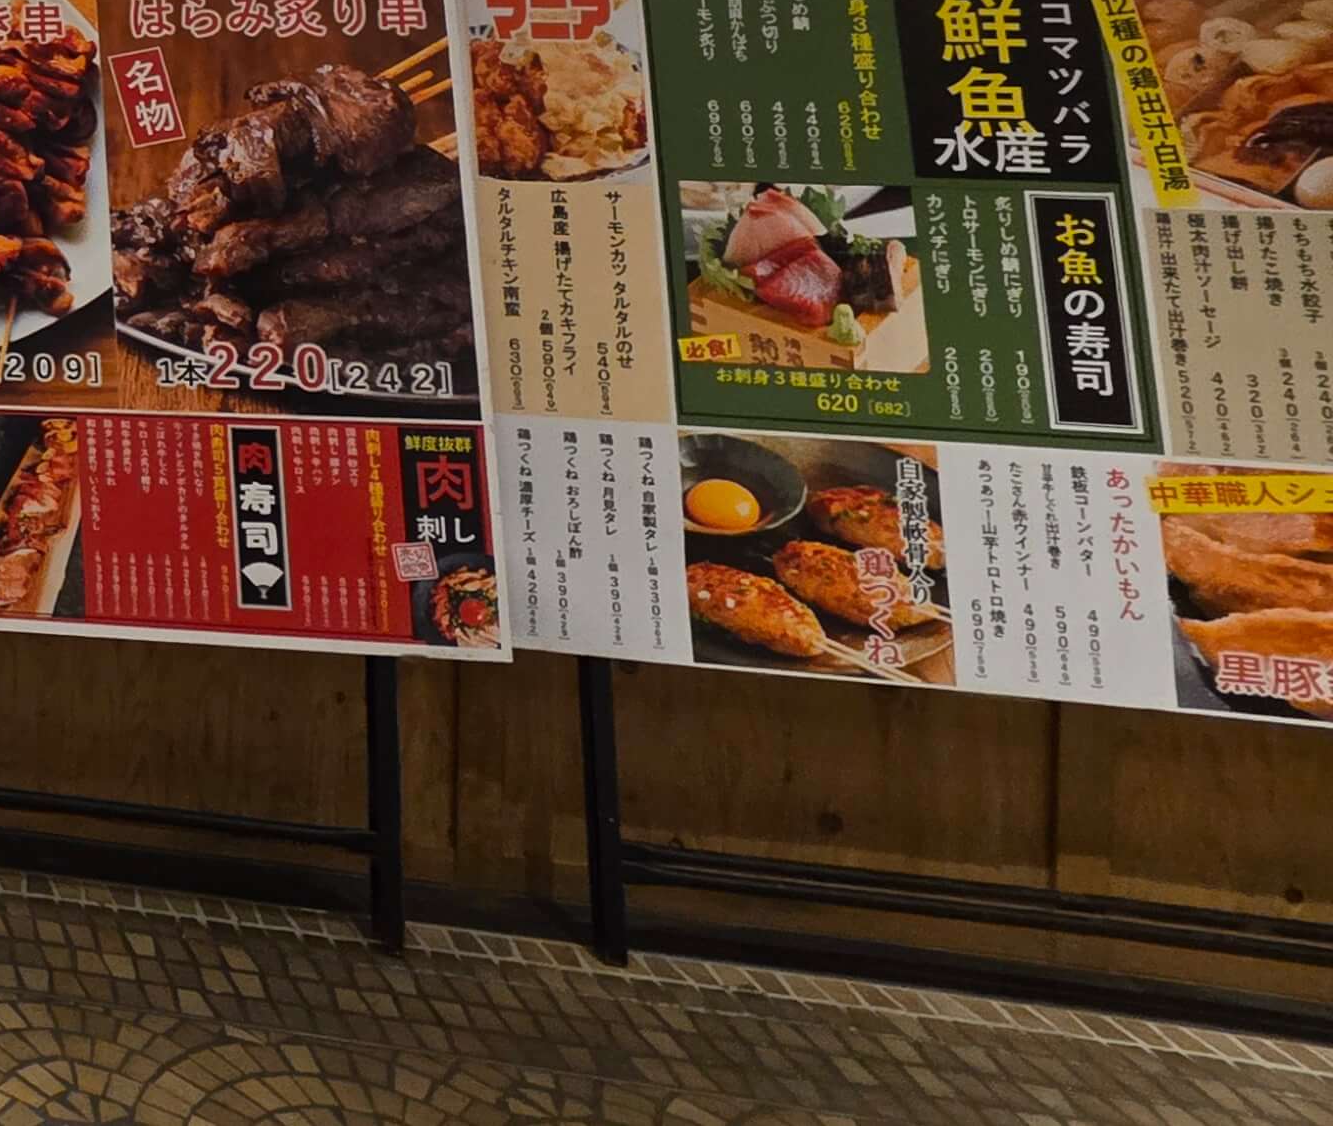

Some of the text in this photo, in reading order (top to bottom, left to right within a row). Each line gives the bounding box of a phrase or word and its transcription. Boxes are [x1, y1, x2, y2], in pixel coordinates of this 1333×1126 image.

[124, 59, 177, 137] 名物
[1041, 3, 1093, 164] コマツバラ
[933, 125, 1052, 174] 水産
[497, 186, 522, 317] タルタルチキン南蛮
[550, 189, 581, 376] 広島産 揚げたてカキフライ
[604, 190, 635, 370] サーモンカツ タルタルのせ
[1054, 212, 1115, 397] お魚の寿司
[404, 434, 473, 454] 鮮度抜群
[816, 392, 860, 414] 620
[237, 441, 280, 557] 肉寿司
[414, 513, 477, 545] 刺し
[415, 454, 475, 511] 肉
[1069, 464, 1095, 578] 鉄板コーンバター
[1105, 468, 1145, 622] あったかいもん
[855, 547, 904, 668] 鶏つくね
[1217, 652, 1333, 699] 黒豚
